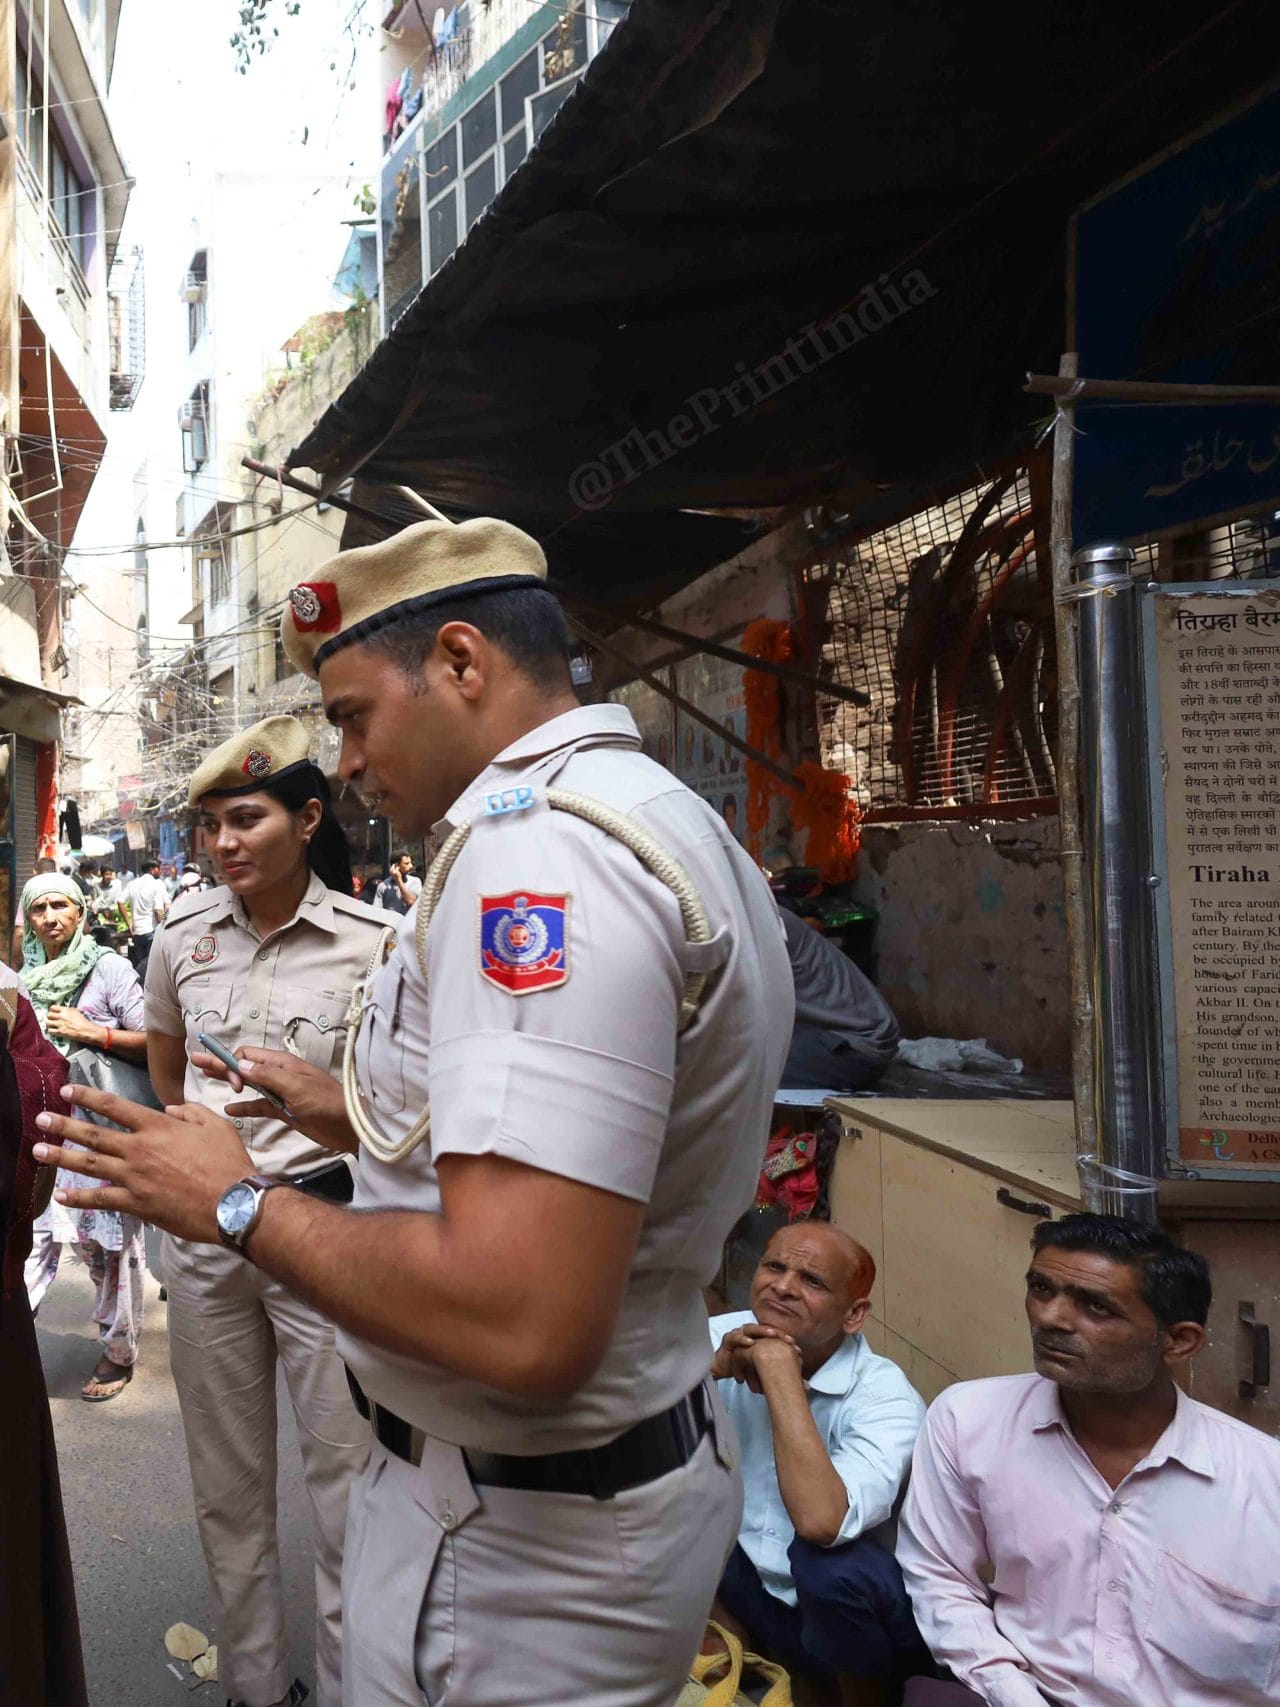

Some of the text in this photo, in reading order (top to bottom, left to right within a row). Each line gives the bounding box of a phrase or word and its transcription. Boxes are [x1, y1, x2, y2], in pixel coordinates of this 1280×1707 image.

[1176, 610, 1237, 632] तिराहा
[1178, 648, 1193, 659] इस
[1197, 645, 1224, 658] तिराहे
[1226, 644, 1238, 656] के
[1178, 662, 1192, 674] की
[1226, 662, 1239, 672] का
[1243, 660, 1270, 674] हिस्सा
[1180, 678, 1200, 689] और
[1205, 677, 1229, 689] 18वीं
[1233, 677, 1269, 689] शताब्दी
[1180, 694, 1203, 706] लोगों
[1208, 693, 1218, 705] के
[1223, 695, 1241, 705] पास
[1246, 693, 1262, 706] रही
[1229, 711, 1263, 722] अहमद
[1182, 728, 1201, 738] फिर
[1233, 728, 1261, 737] सम्राट
[1182, 745, 1197, 754] घर
[1224, 742, 1250, 754] उनके
[1184, 761, 1218, 770] स्थापना
[1222, 759, 1236, 770] की
[1240, 759, 1261, 770] जिसे
[1184, 774, 1277, 788] सैयद ने दोनों घरों में
[1185, 794, 1201, 805] वह
[1206, 792, 1235, 804] दिल्ली
[1241, 791, 1252, 803] के
[1186, 807, 1275, 821] ऐतिहासिक स्मारकों
[1186, 824, 1276, 838] में से एक लिखी थी
[1187, 843, 1223, 856] पुरातत्व
[1226, 840, 1262, 853] सर्वेक्षण
[1188, 865, 1270, 882] Tiraha
[1190, 898, 1213, 908] The
[1218, 900, 1242, 908] area
[1192, 912, 1229, 924] family
[1234, 912, 1273, 922] related
[1192, 927, 1219, 936] after
[1222, 927, 1264, 936] Bairam
[1192, 942, 1239, 952] century.
[1243, 942, 1259, 952] By
[1193, 955, 1208, 964] be
[1212, 955, 1265, 967] occupied
[1233, 969, 1246, 979] of
[1195, 984, 1238, 993] various
[1196, 998, 1232, 1007] Akbar
[1253, 998, 1271, 1007] On
[1196, 1012, 1216, 1022] His
[1197, 1026, 1242, 1036] founder
[1247, 1026, 1260, 1036] of
[1197, 1040, 1228, 1050] spent
[1231, 1040, 1258, 1050] time
[1261, 1040, 1272, 1050] in
[1198, 1055, 1216, 1064] the
[1198, 1069, 1242, 1079] cultural
[1224, 1083, 1238, 1093] of
[1241, 1083, 1259, 1093] the
[1199, 1097, 1222, 1107] also
[1249, 1150, 1259, 1160] A
